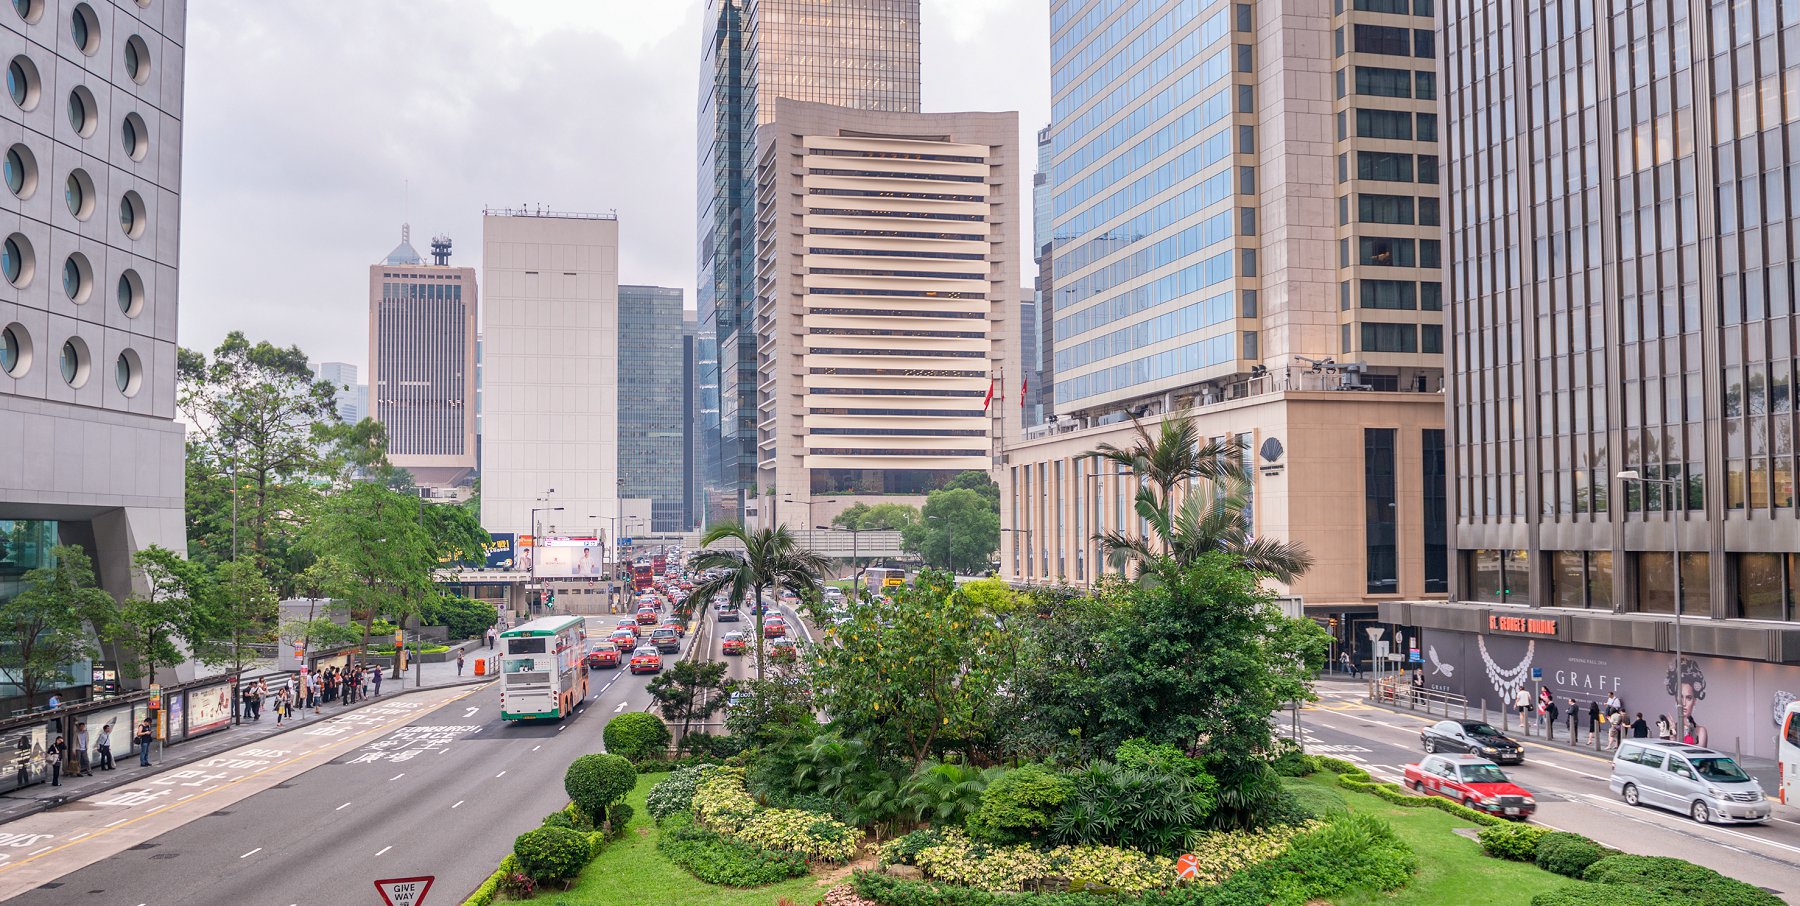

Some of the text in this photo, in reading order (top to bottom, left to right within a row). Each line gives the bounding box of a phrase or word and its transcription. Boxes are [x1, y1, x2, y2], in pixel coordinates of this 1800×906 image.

[1527, 618, 1556, 635] BUILDING
[1555, 670, 1622, 692] GRAFF
[1431, 683, 1450, 692] GRAFF
[389, 732, 462, 740] PLACE
[238, 748, 292, 758] BUS
[198, 758, 271, 769] STOP
[150, 770, 229, 787] 巴士
[393, 883, 415, 892] GIVE
[394, 892, 415, 901] WAY
